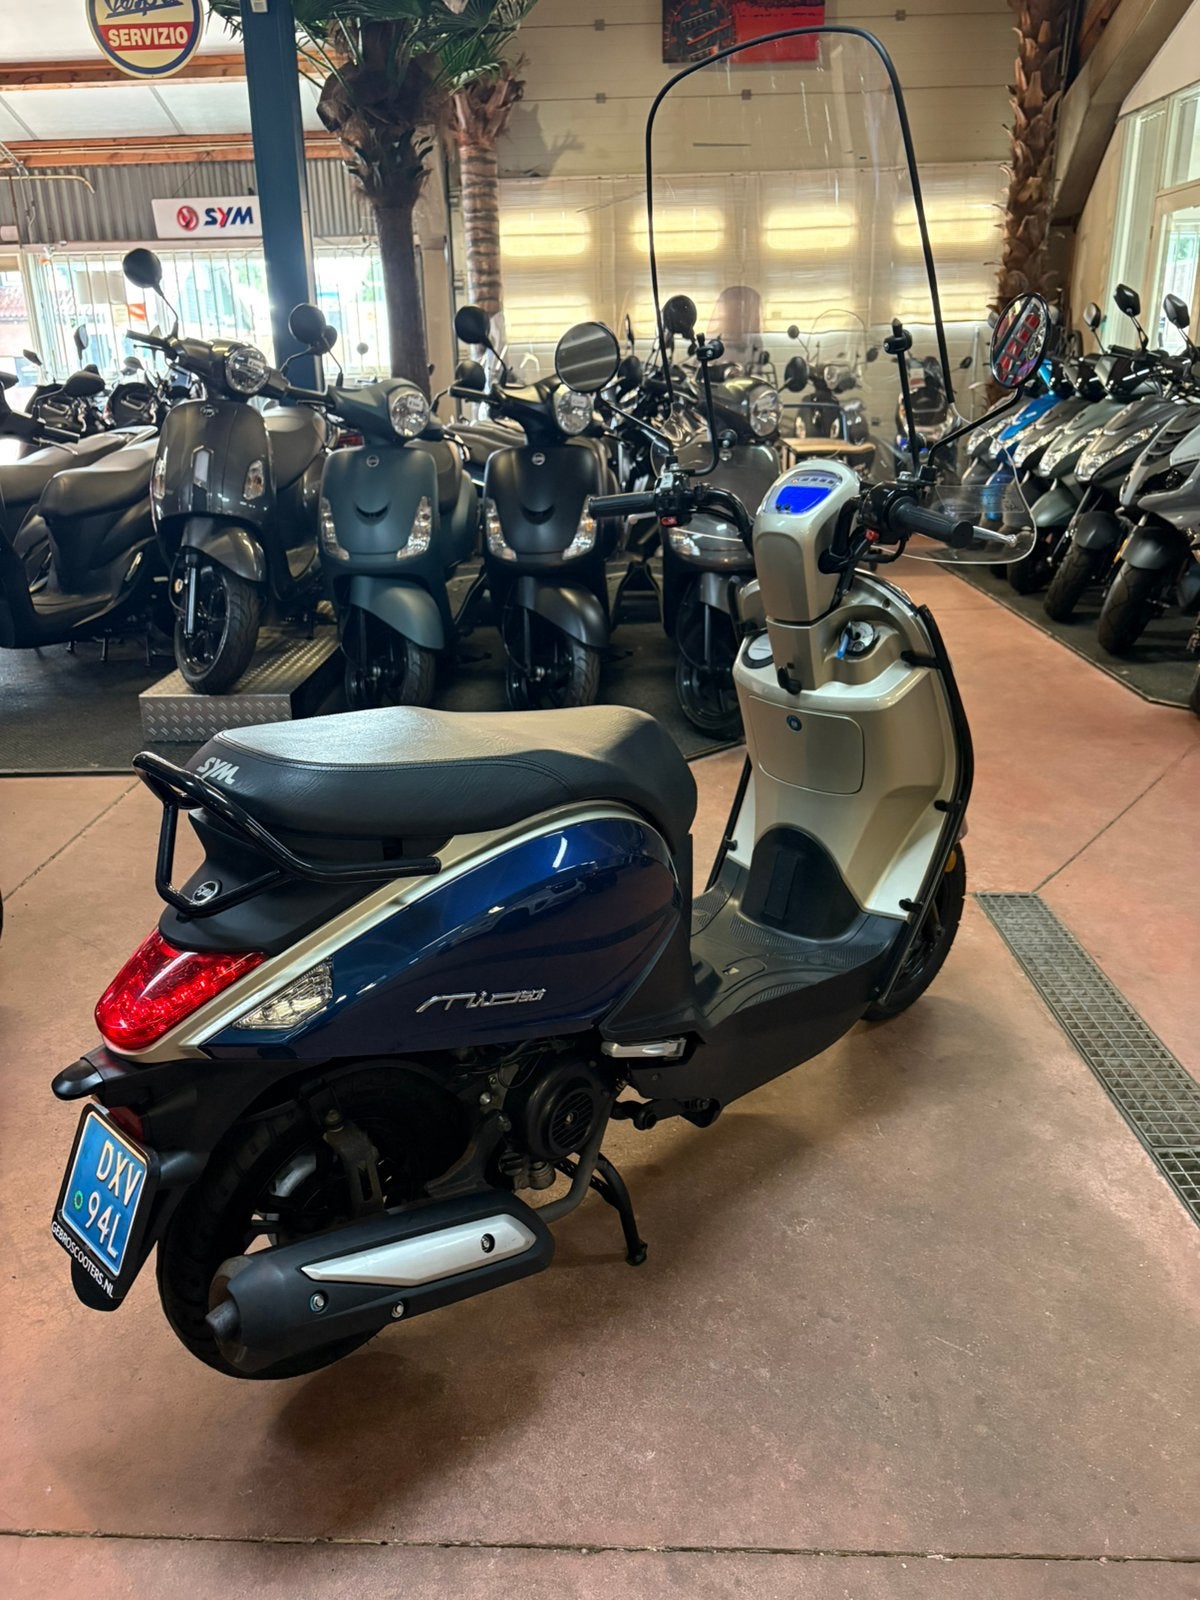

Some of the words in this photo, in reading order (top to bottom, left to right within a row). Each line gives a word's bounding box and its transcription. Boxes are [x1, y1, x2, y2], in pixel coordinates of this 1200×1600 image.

[107, 26, 189, 47] SERVIZIO
[203, 206, 255, 228] SYM
[196, 756, 240, 785] SYM
[96, 1139, 142, 1207] DXV
[85, 1191, 122, 1258] 94L
[51, 1221, 114, 1298] GEBROSCOOTERS.NL
